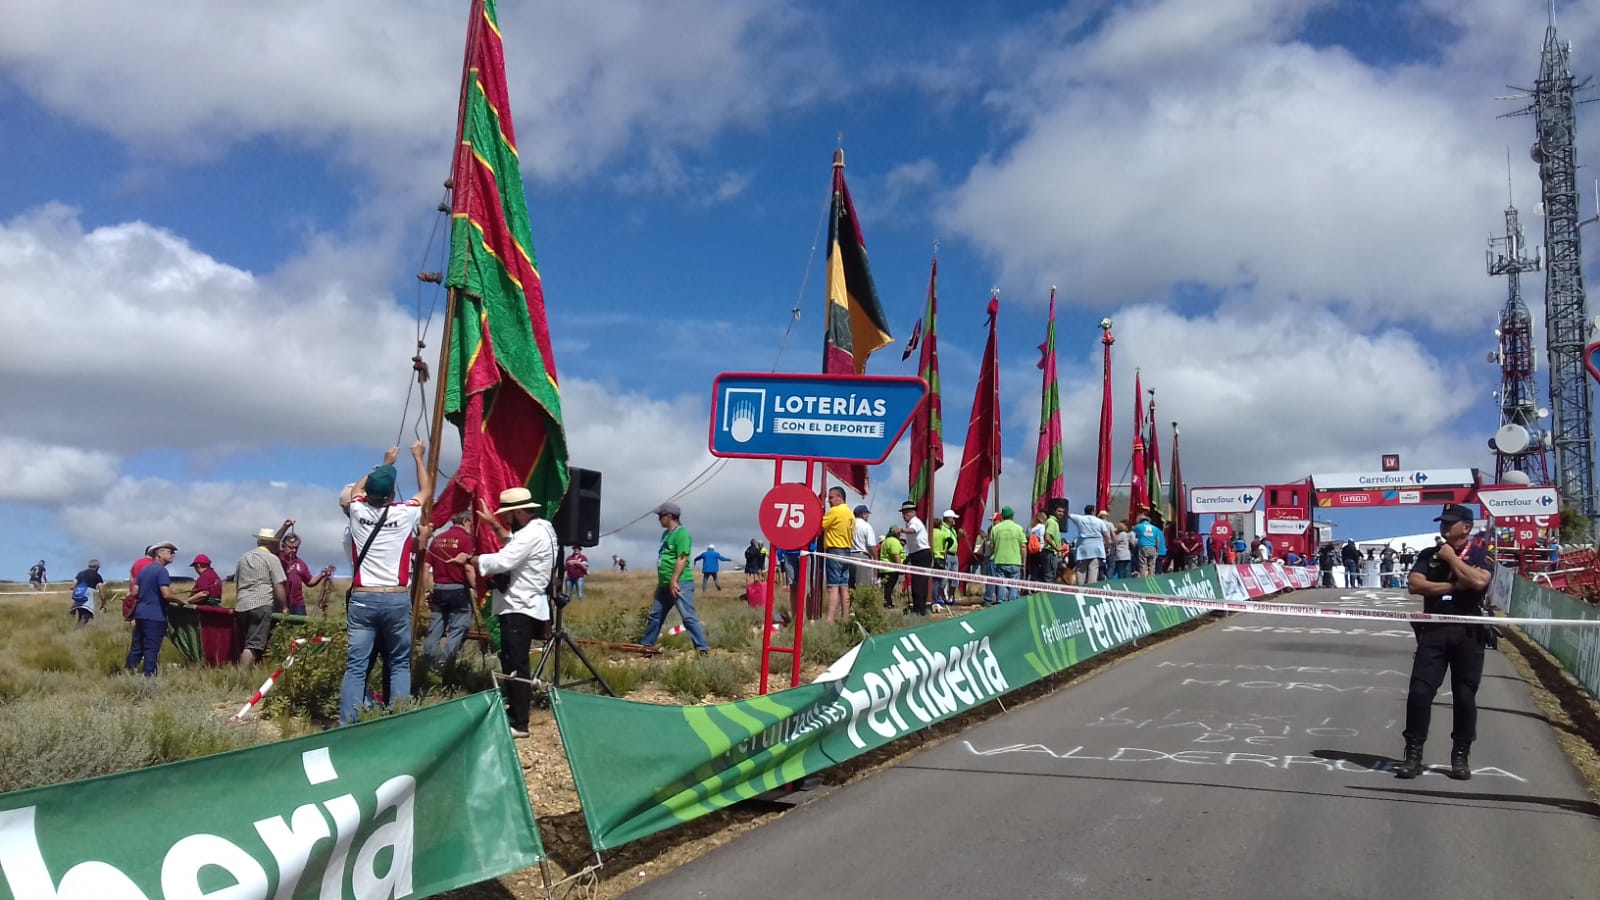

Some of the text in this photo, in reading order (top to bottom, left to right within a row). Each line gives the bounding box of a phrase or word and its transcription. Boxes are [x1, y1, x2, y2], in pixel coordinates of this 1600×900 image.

[774, 394, 887, 417] LOTERÍAS
[781, 421, 877, 434] CON EL DEPORTE
[1359, 475, 1405, 484] Carrefour
[1195, 495, 1235, 504] Carrefour
[1488, 498, 1532, 507] Carrefour
[773, 503, 805, 529] 75
[1216, 526, 1228, 535] 50
[1520, 530, 1533, 539] 50
[1041, 617, 1085, 645] Fertilizantes
